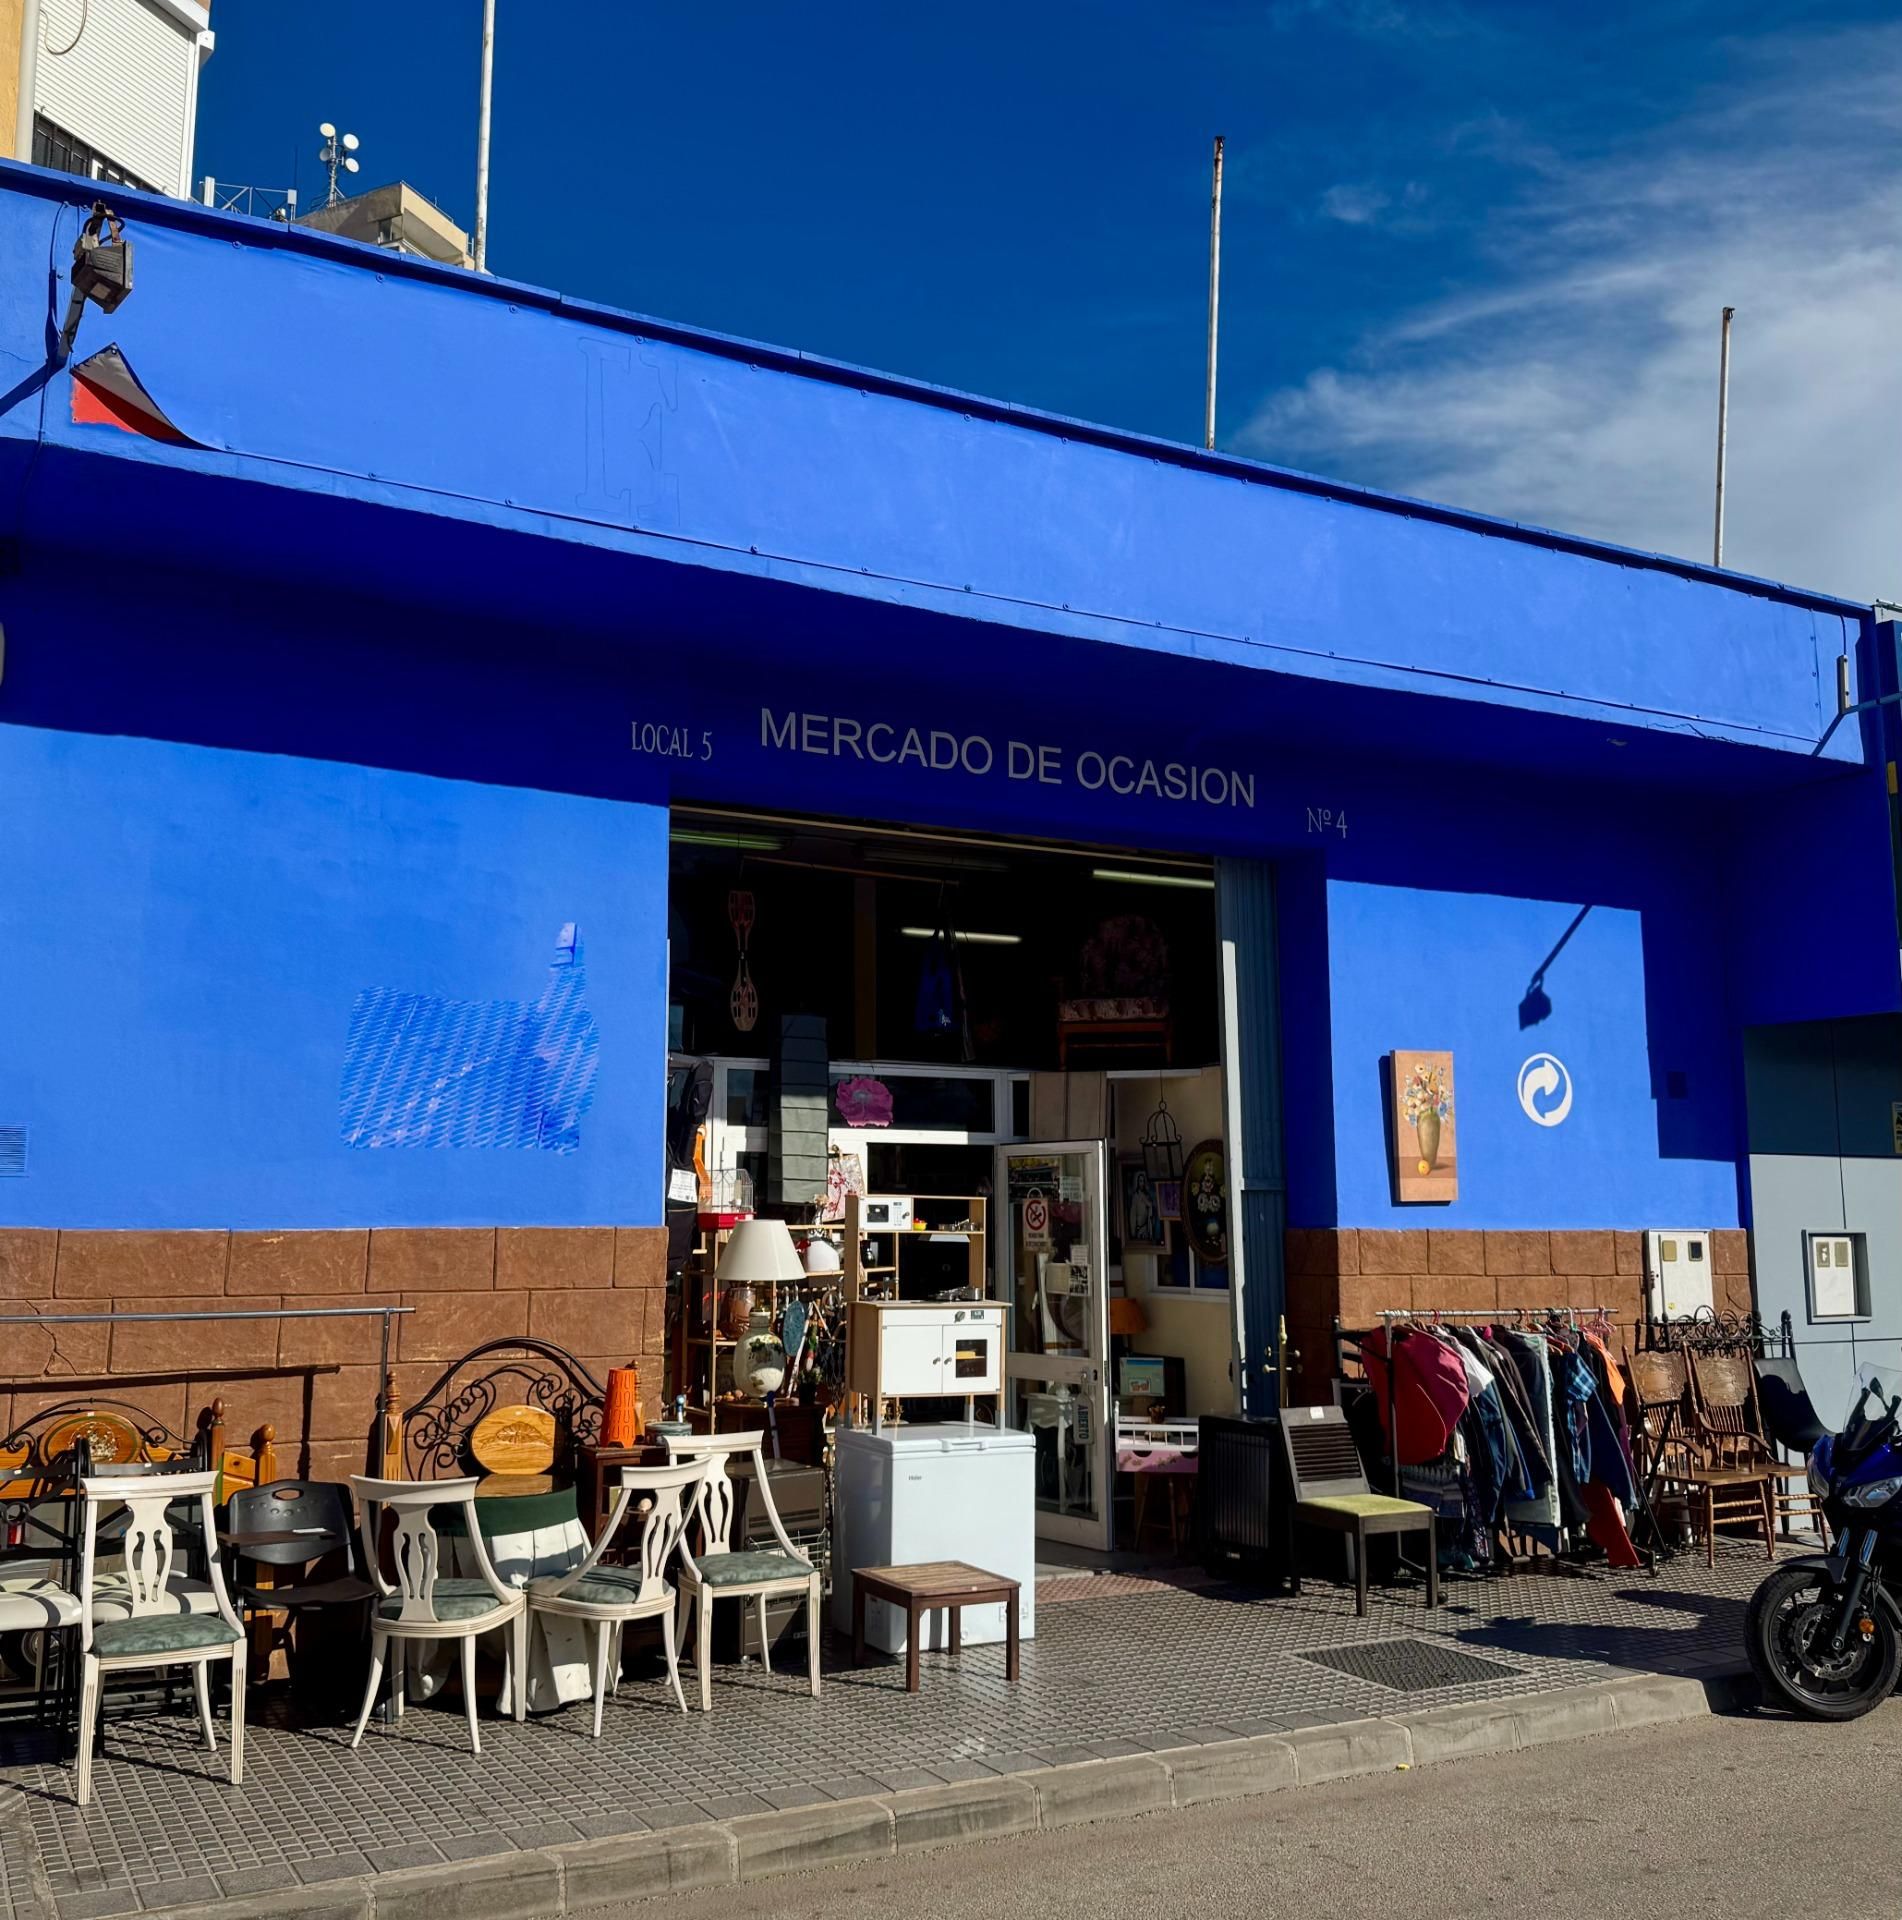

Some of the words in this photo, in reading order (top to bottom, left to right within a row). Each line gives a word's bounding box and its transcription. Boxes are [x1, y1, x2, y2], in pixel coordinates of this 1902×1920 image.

[631, 721, 694, 758] LOCAL
[700, 731, 713, 761] 5
[761, 707, 993, 775] MERCADO
[1008, 740, 1063, 785] DE
[1076, 751, 1255, 808] OCASION
[1335, 809, 1348, 839] 4
